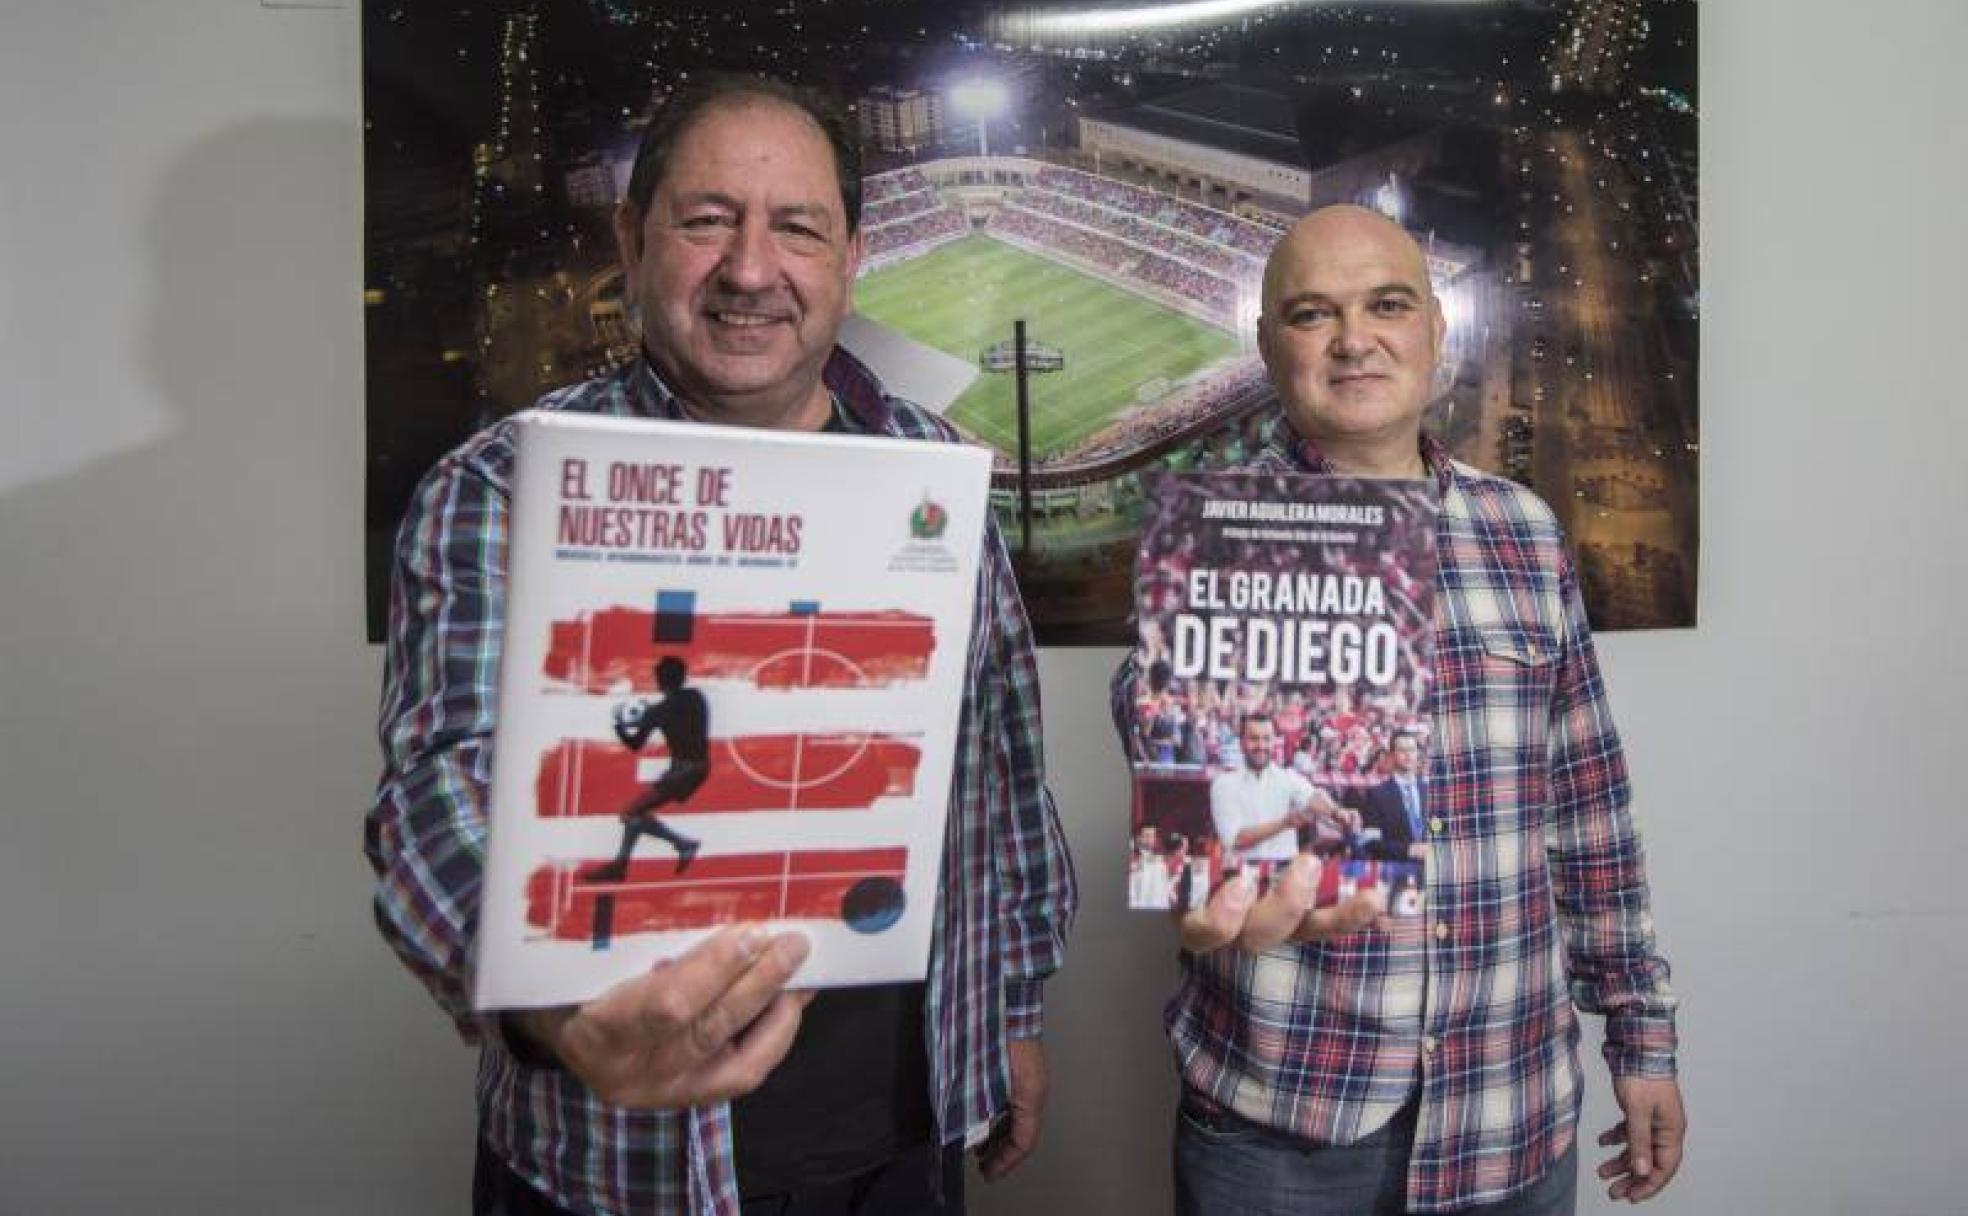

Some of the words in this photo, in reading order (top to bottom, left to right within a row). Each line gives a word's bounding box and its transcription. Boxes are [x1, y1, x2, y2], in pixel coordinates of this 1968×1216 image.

[560, 458, 592, 500] EL
[609, 461, 684, 505] ONCE
[696, 467, 733, 507] DE
[558, 504, 708, 551] NUESTRAS
[723, 513, 803, 554] VIDAS
[1203, 500, 1248, 519] JAVIER
[1250, 502, 1316, 522] AGUILERA
[1316, 504, 1384, 526] MORALES
[1190, 569, 1225, 609] EL
[1230, 570, 1386, 616] GRANADA
[1174, 613, 1239, 680] DE
[1247, 617, 1398, 687] DIEGO
